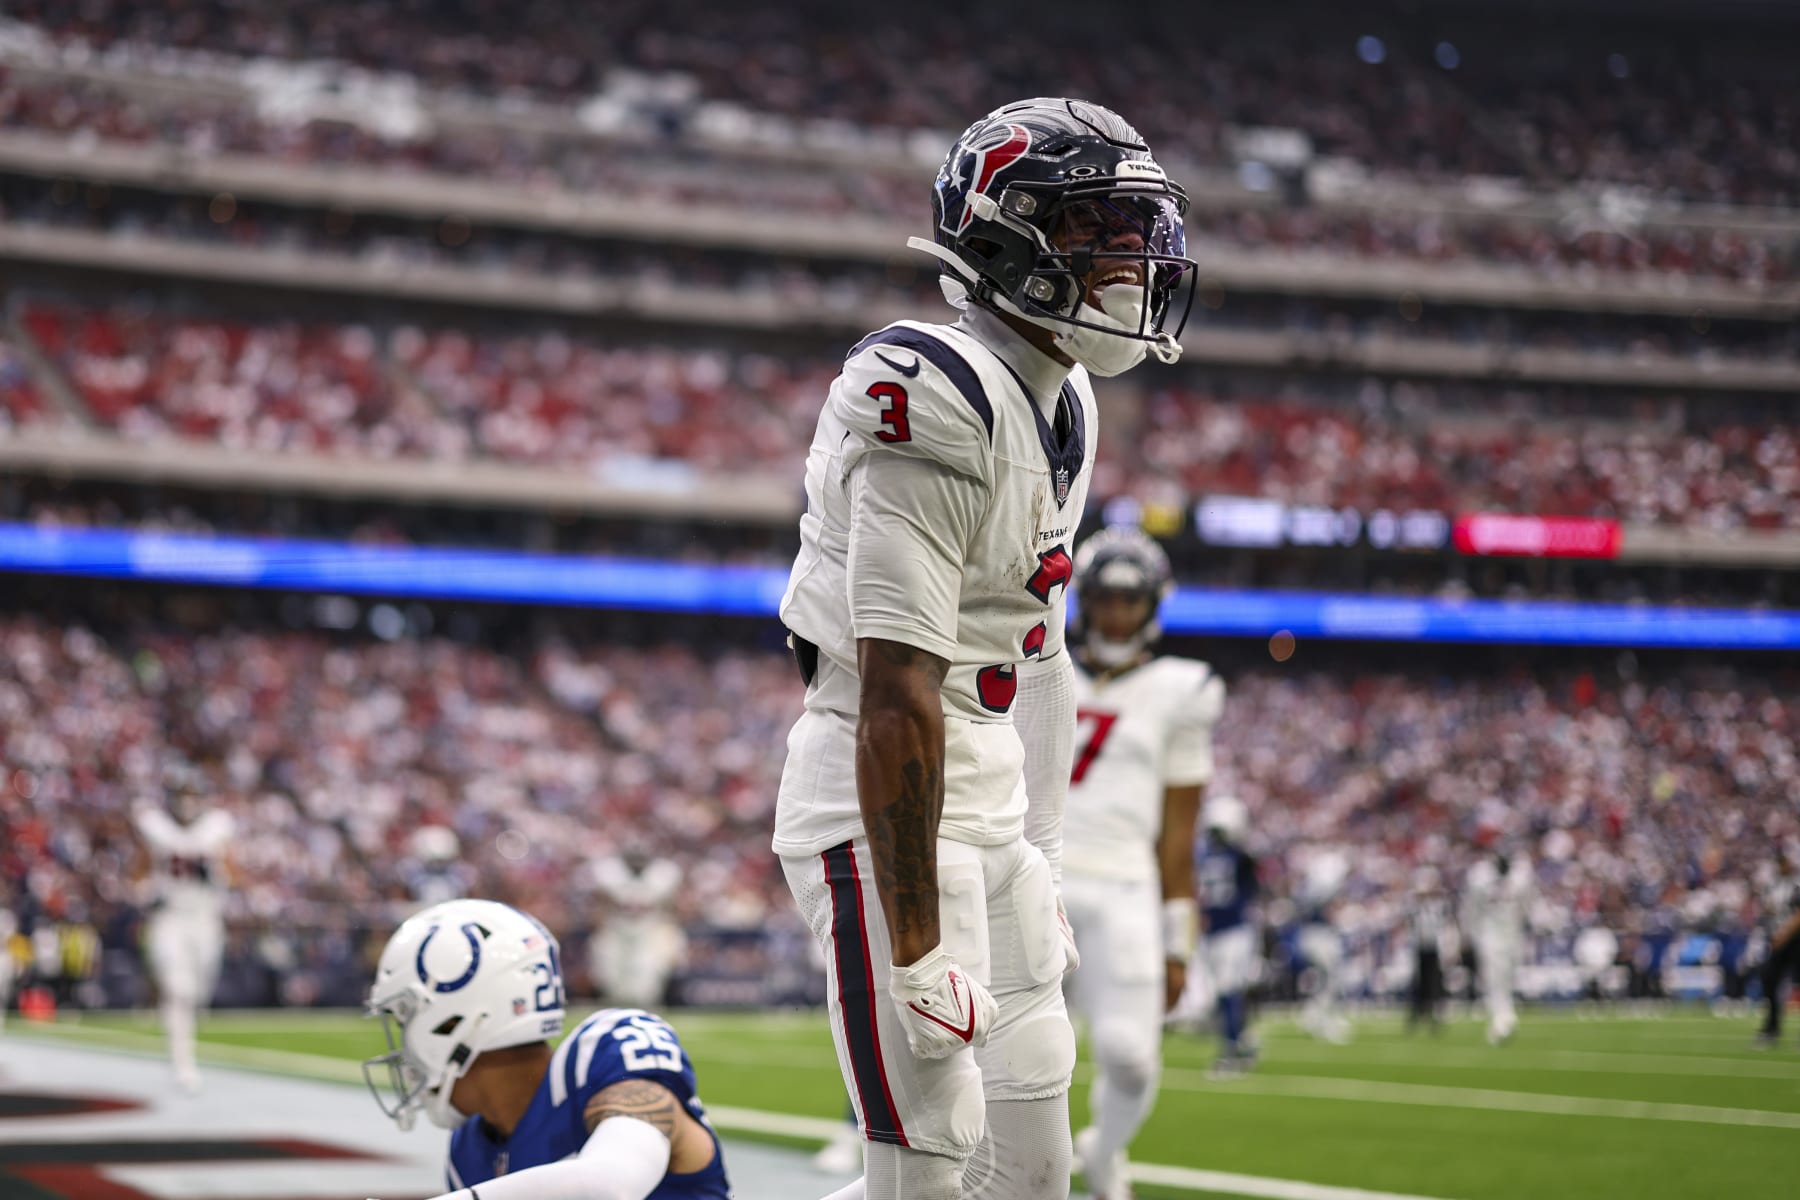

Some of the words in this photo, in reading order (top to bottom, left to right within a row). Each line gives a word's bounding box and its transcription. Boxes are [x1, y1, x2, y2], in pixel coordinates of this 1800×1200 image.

[865, 381, 911, 442] 3
[1071, 708, 1118, 784] 7
[612, 1016, 683, 1073] 25
